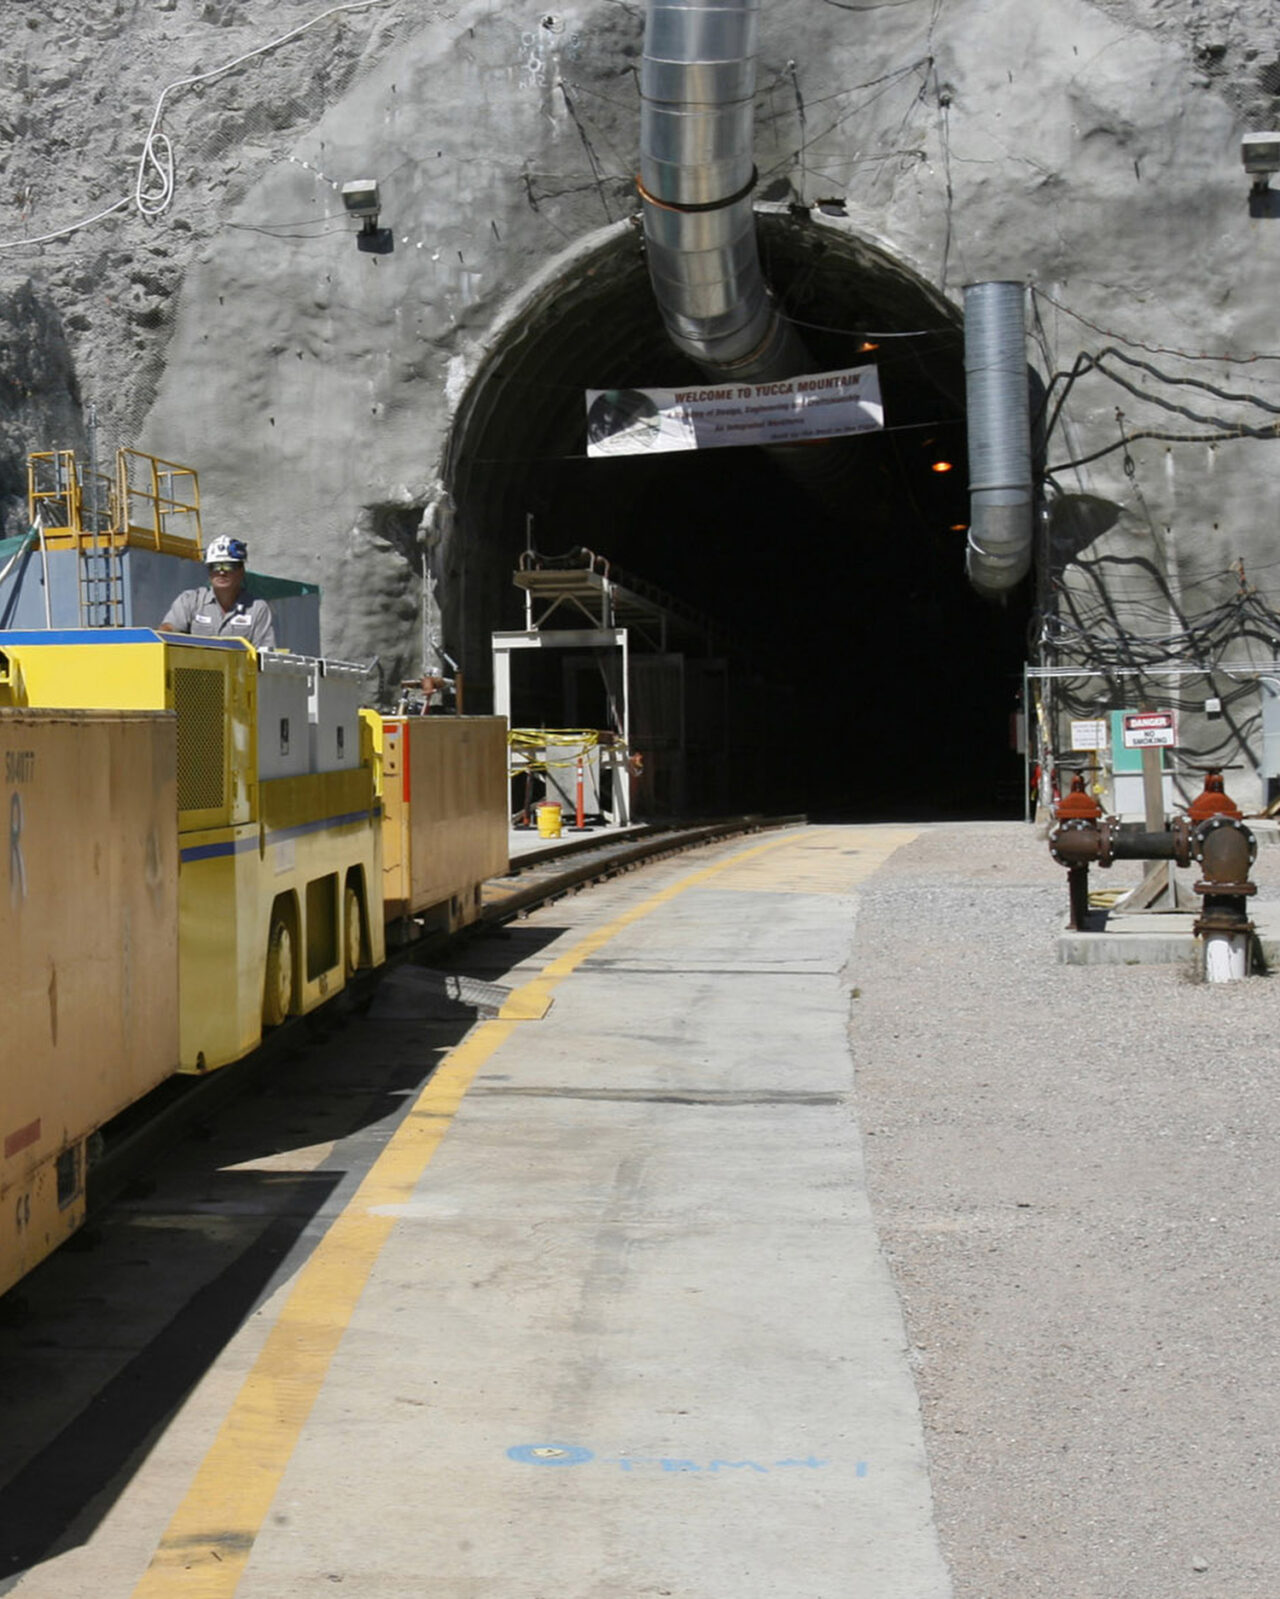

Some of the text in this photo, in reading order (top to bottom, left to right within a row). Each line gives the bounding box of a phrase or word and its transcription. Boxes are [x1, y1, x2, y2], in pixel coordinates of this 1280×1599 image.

[674, 373, 861, 404] WELCOME TO YUCCA MOUNTAIN
[1132, 736, 1168, 745] SMOKING
